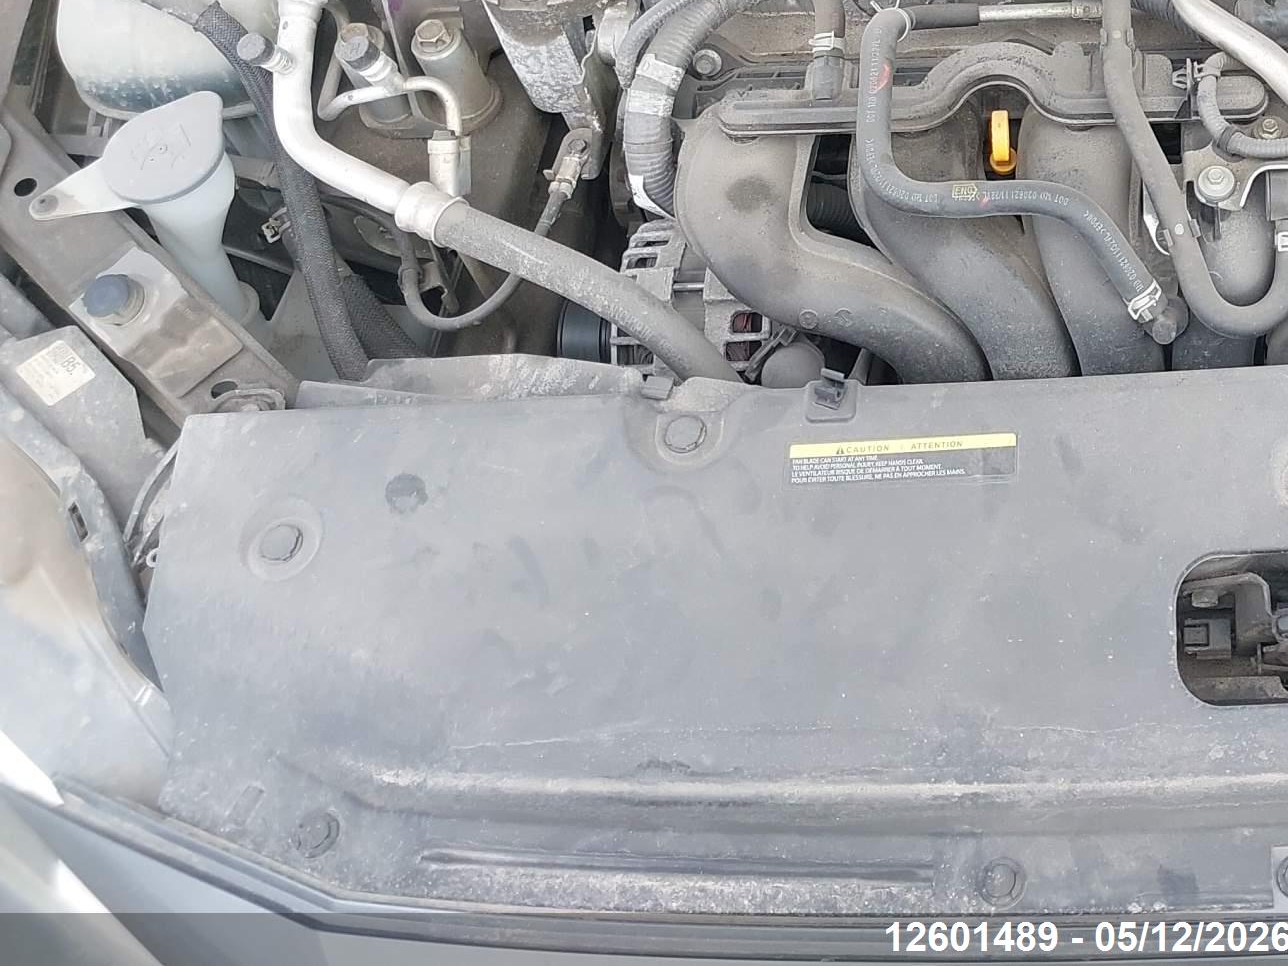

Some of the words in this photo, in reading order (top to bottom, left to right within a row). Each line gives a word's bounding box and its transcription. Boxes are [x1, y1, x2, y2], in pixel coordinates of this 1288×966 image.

[846, 444, 889, 454] CAUTION
[910, 441, 963, 450] ATTENTION
[903, 470, 935, 478] APPROCHER
